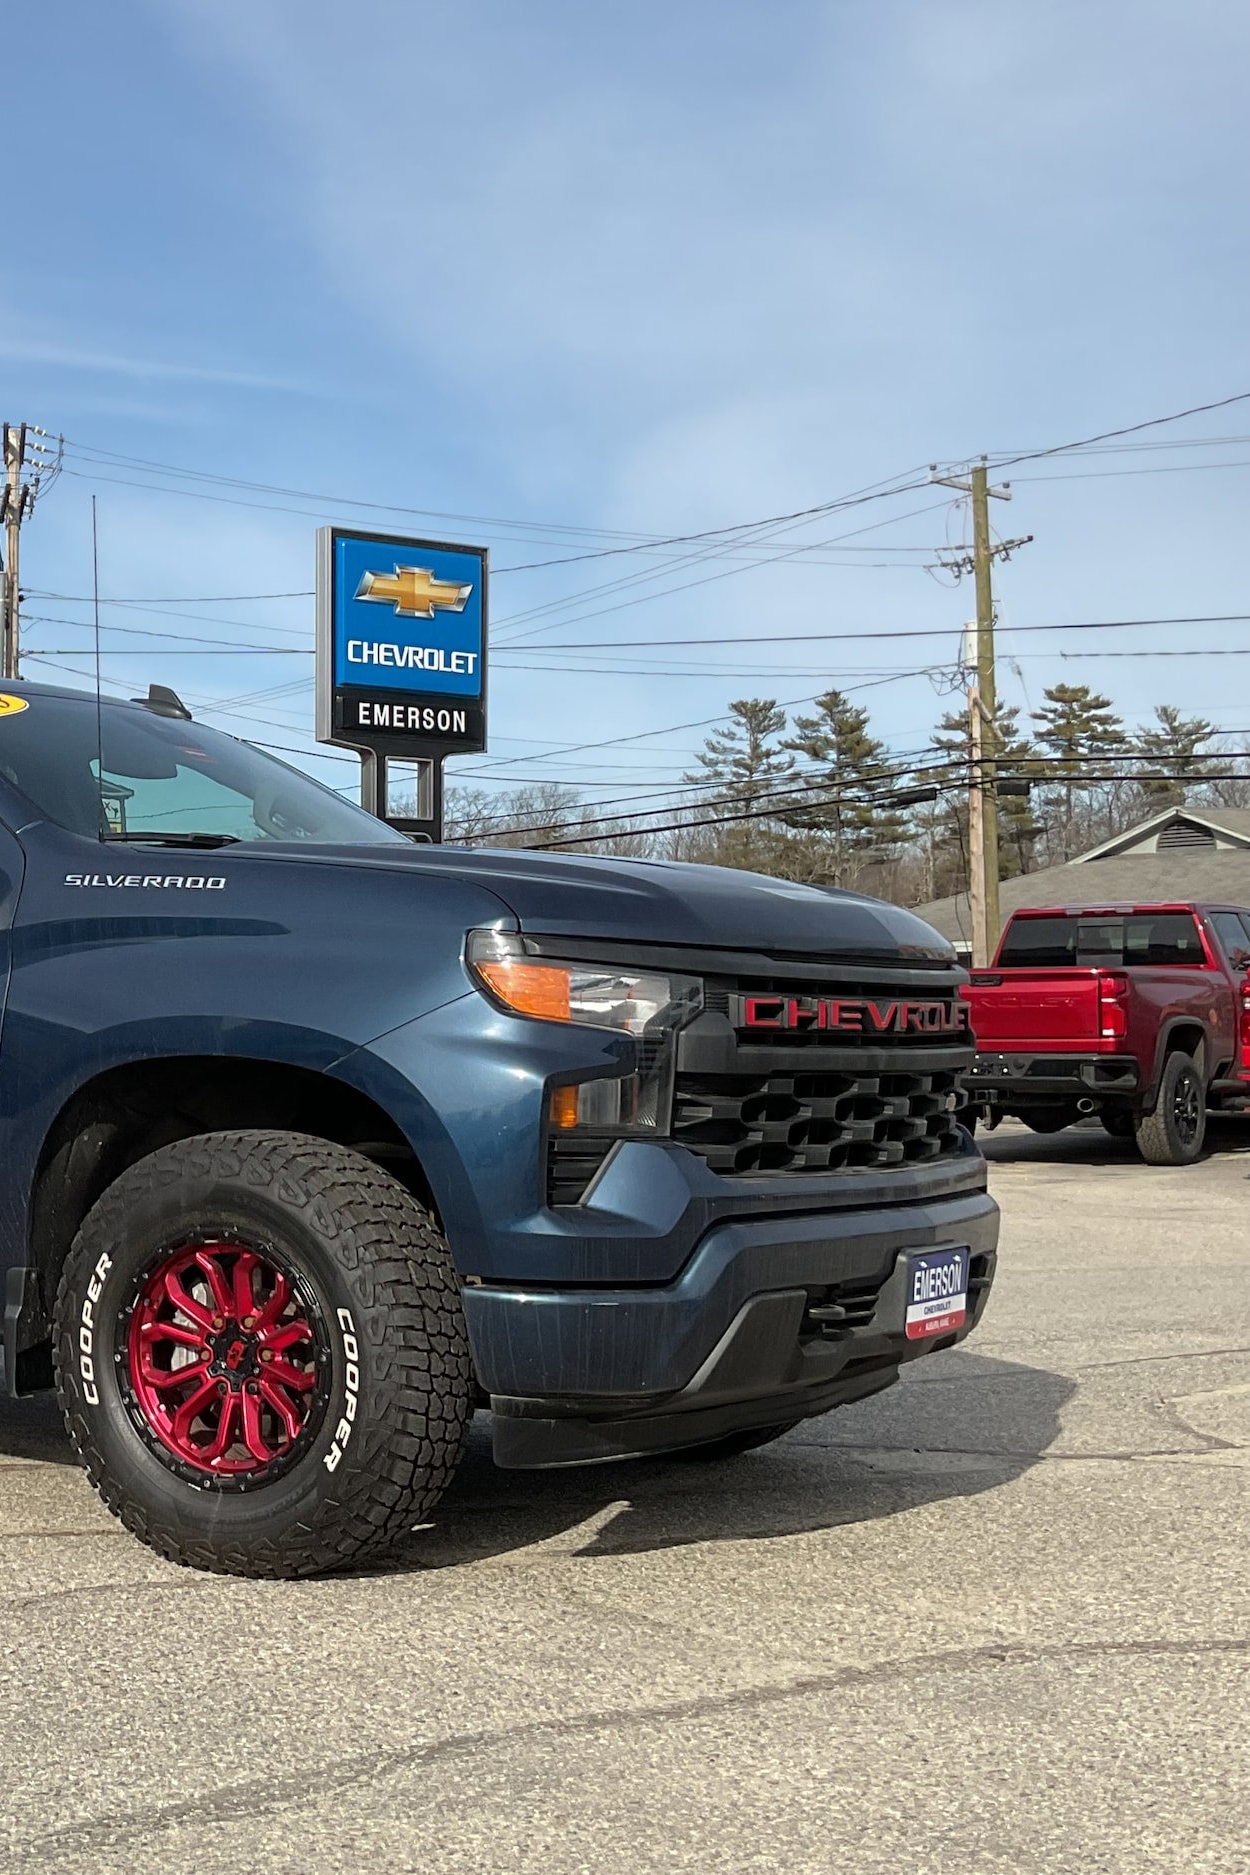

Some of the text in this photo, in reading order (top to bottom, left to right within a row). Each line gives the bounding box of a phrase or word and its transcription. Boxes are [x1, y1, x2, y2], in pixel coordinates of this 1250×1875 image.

[347, 640, 478, 674] CHEVROLET
[358, 702, 466, 732] EMERSON
[64, 874, 227, 890] SILVERADO
[741, 996, 971, 1031] CHEVROLE
[913, 1263, 963, 1302] EMERSON
[80, 1252, 113, 1405] COOPER
[323, 1307, 360, 1473] COOPER
